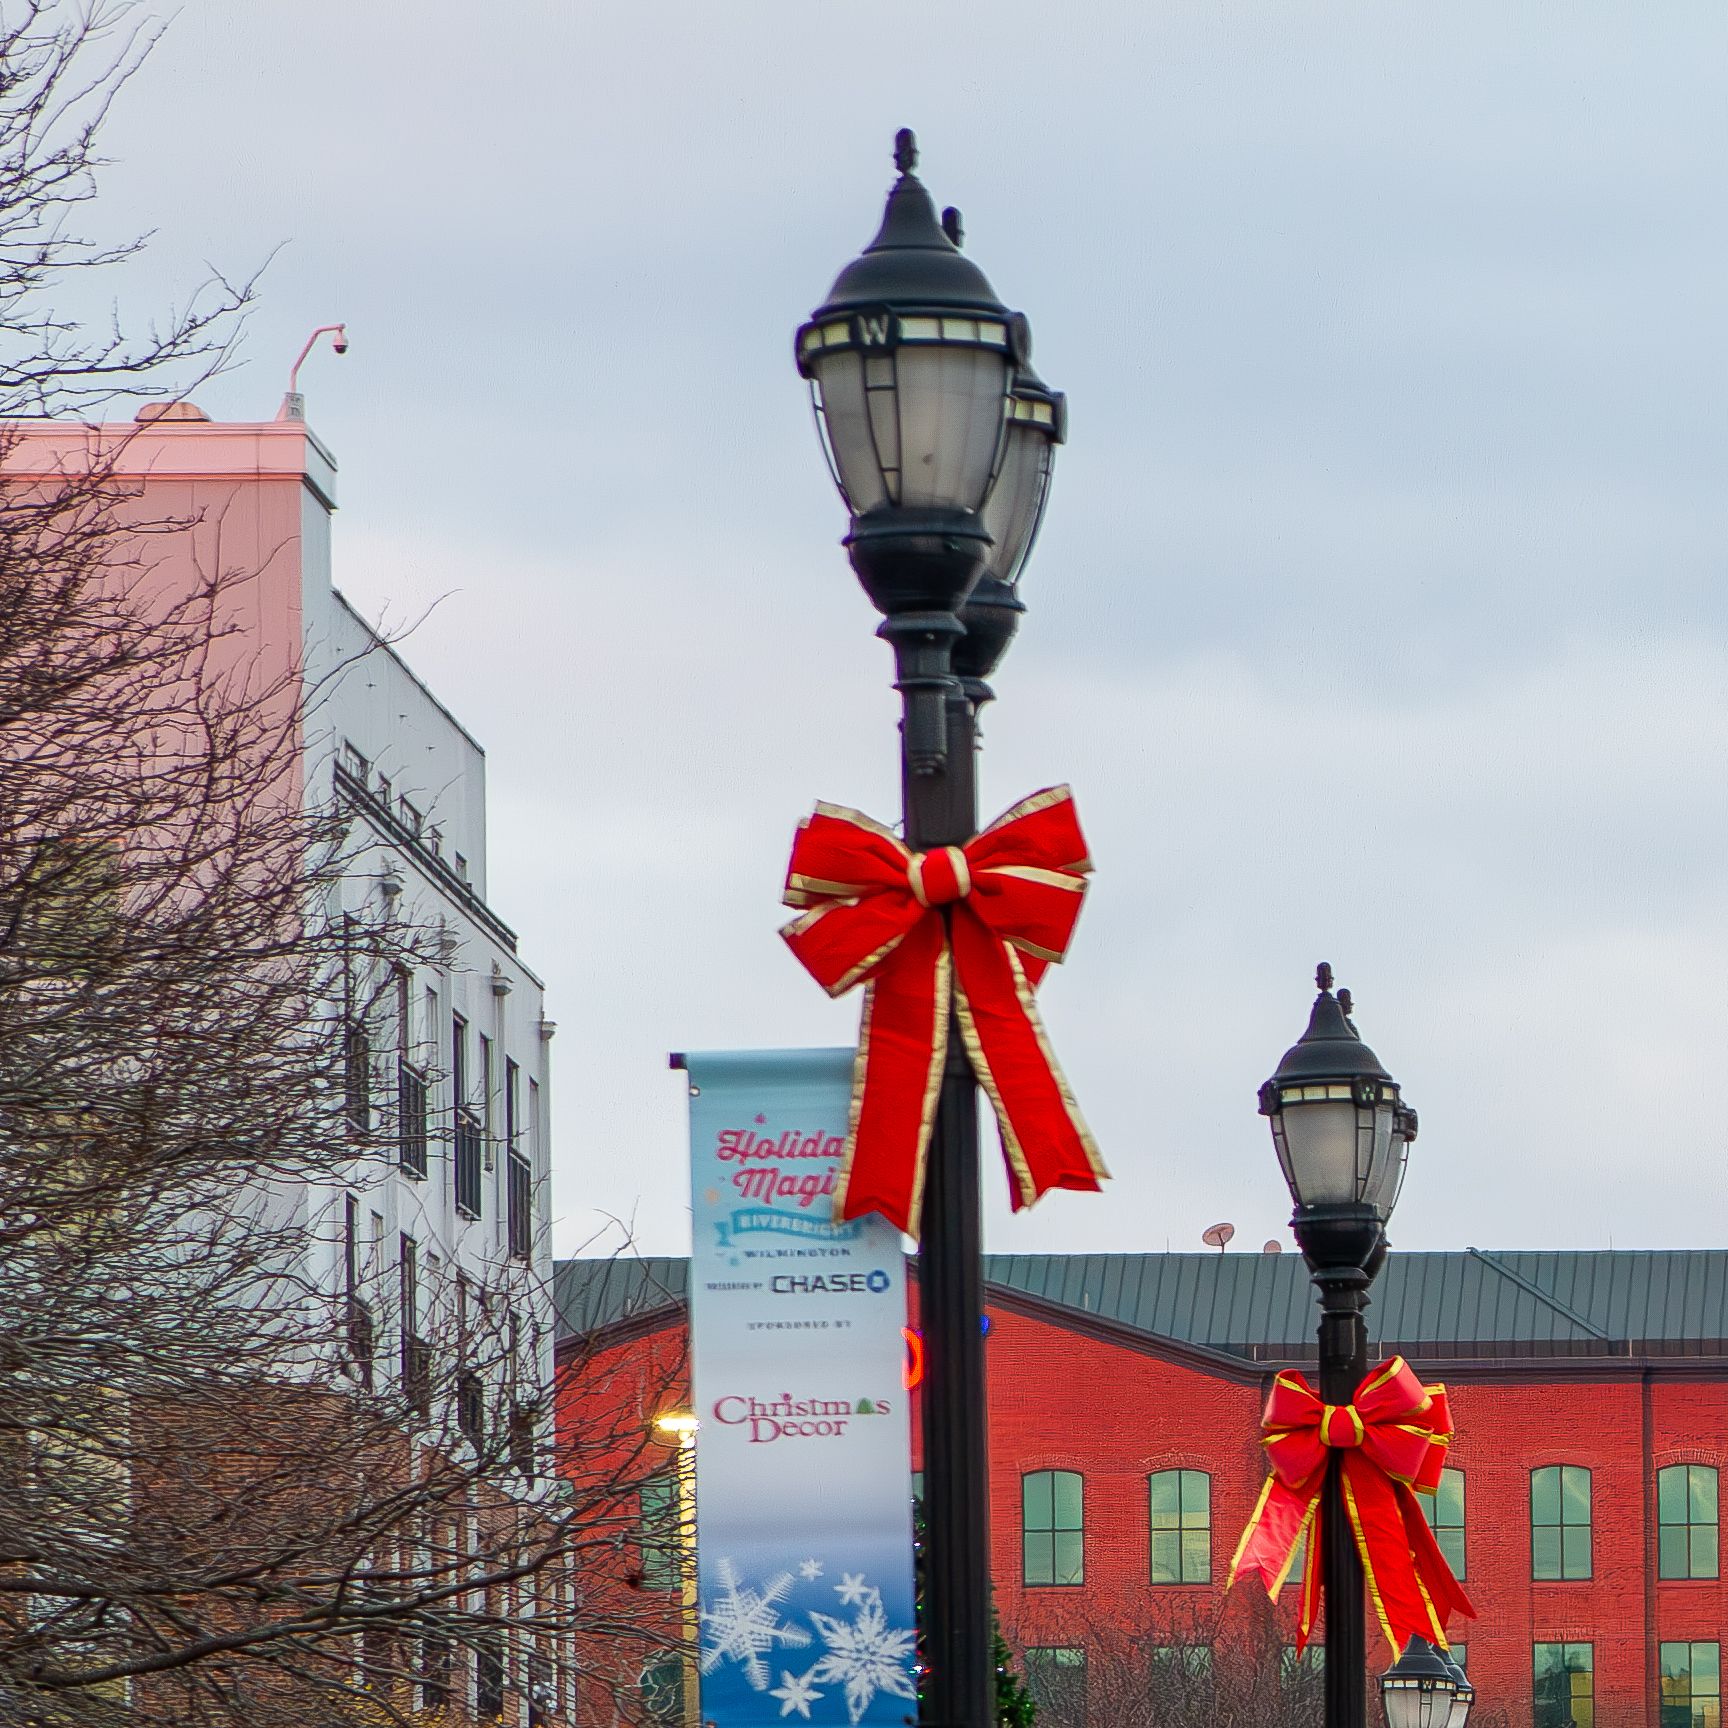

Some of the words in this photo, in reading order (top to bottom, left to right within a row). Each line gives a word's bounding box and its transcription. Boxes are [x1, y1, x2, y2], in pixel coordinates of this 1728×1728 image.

[716, 1129, 846, 1165] Holida
[732, 1166, 838, 1208] Magi
[769, 1274, 866, 1293] CHASE
[748, 1417, 848, 1443] Decor
